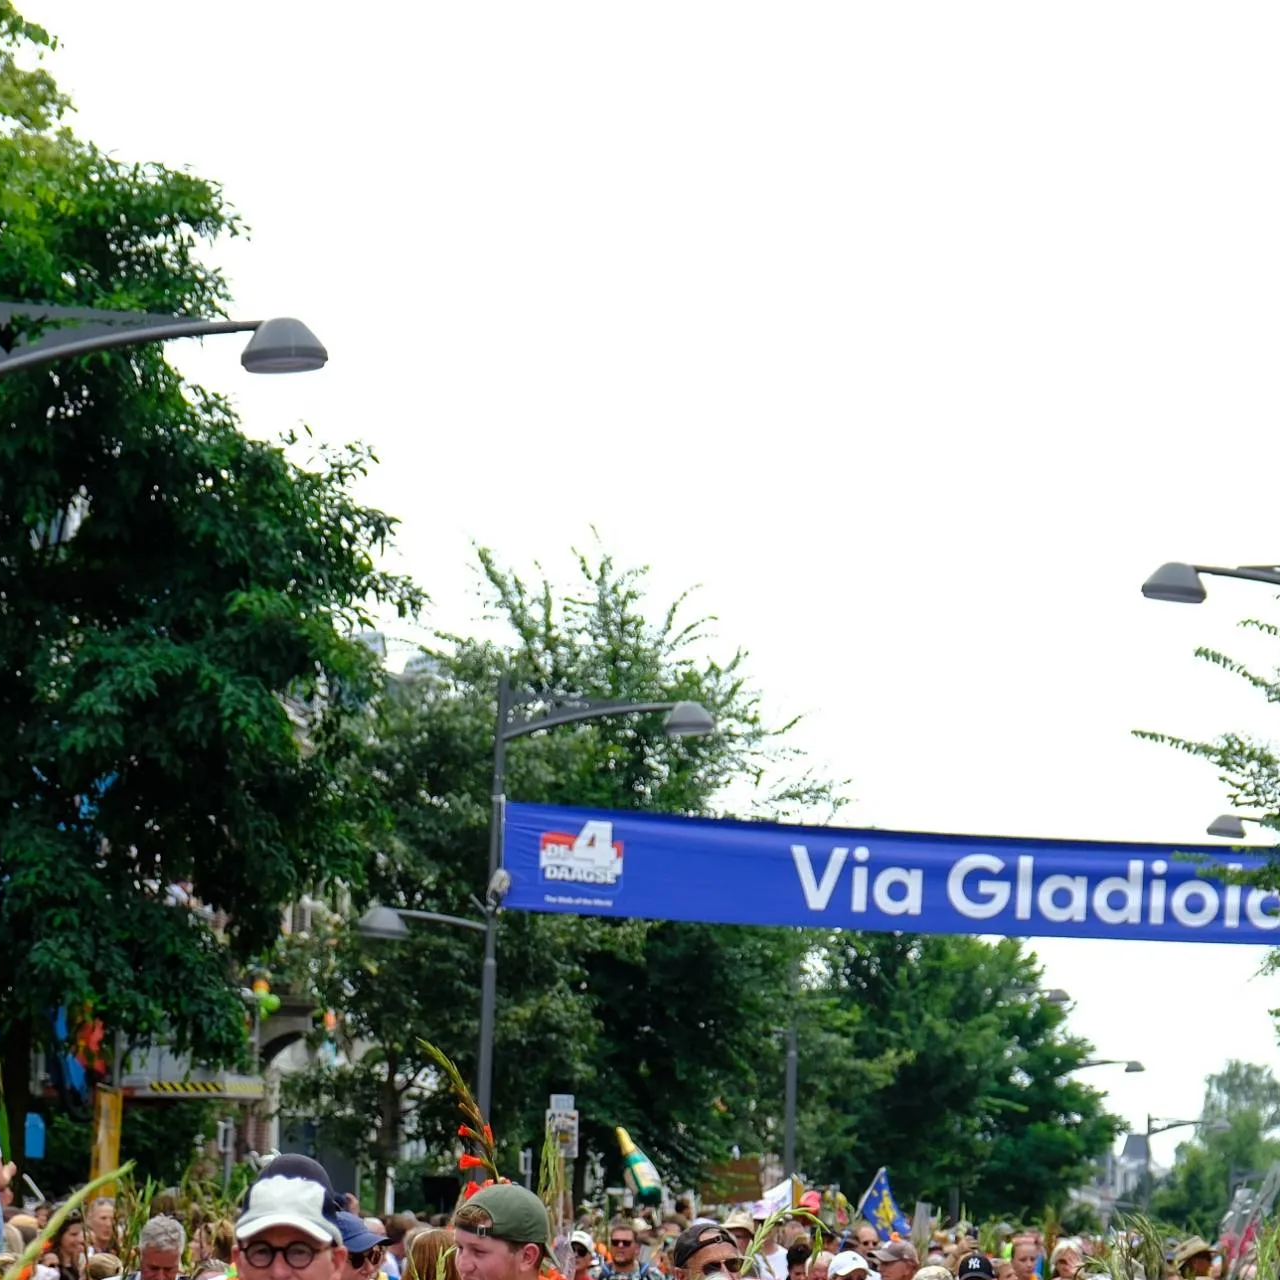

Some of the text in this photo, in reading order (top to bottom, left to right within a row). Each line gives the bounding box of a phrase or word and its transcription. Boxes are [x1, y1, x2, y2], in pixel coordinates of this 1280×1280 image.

[574, 820, 614, 868] 4
[545, 864, 617, 884] DAAGSE
[790, 844, 924, 916] Via
